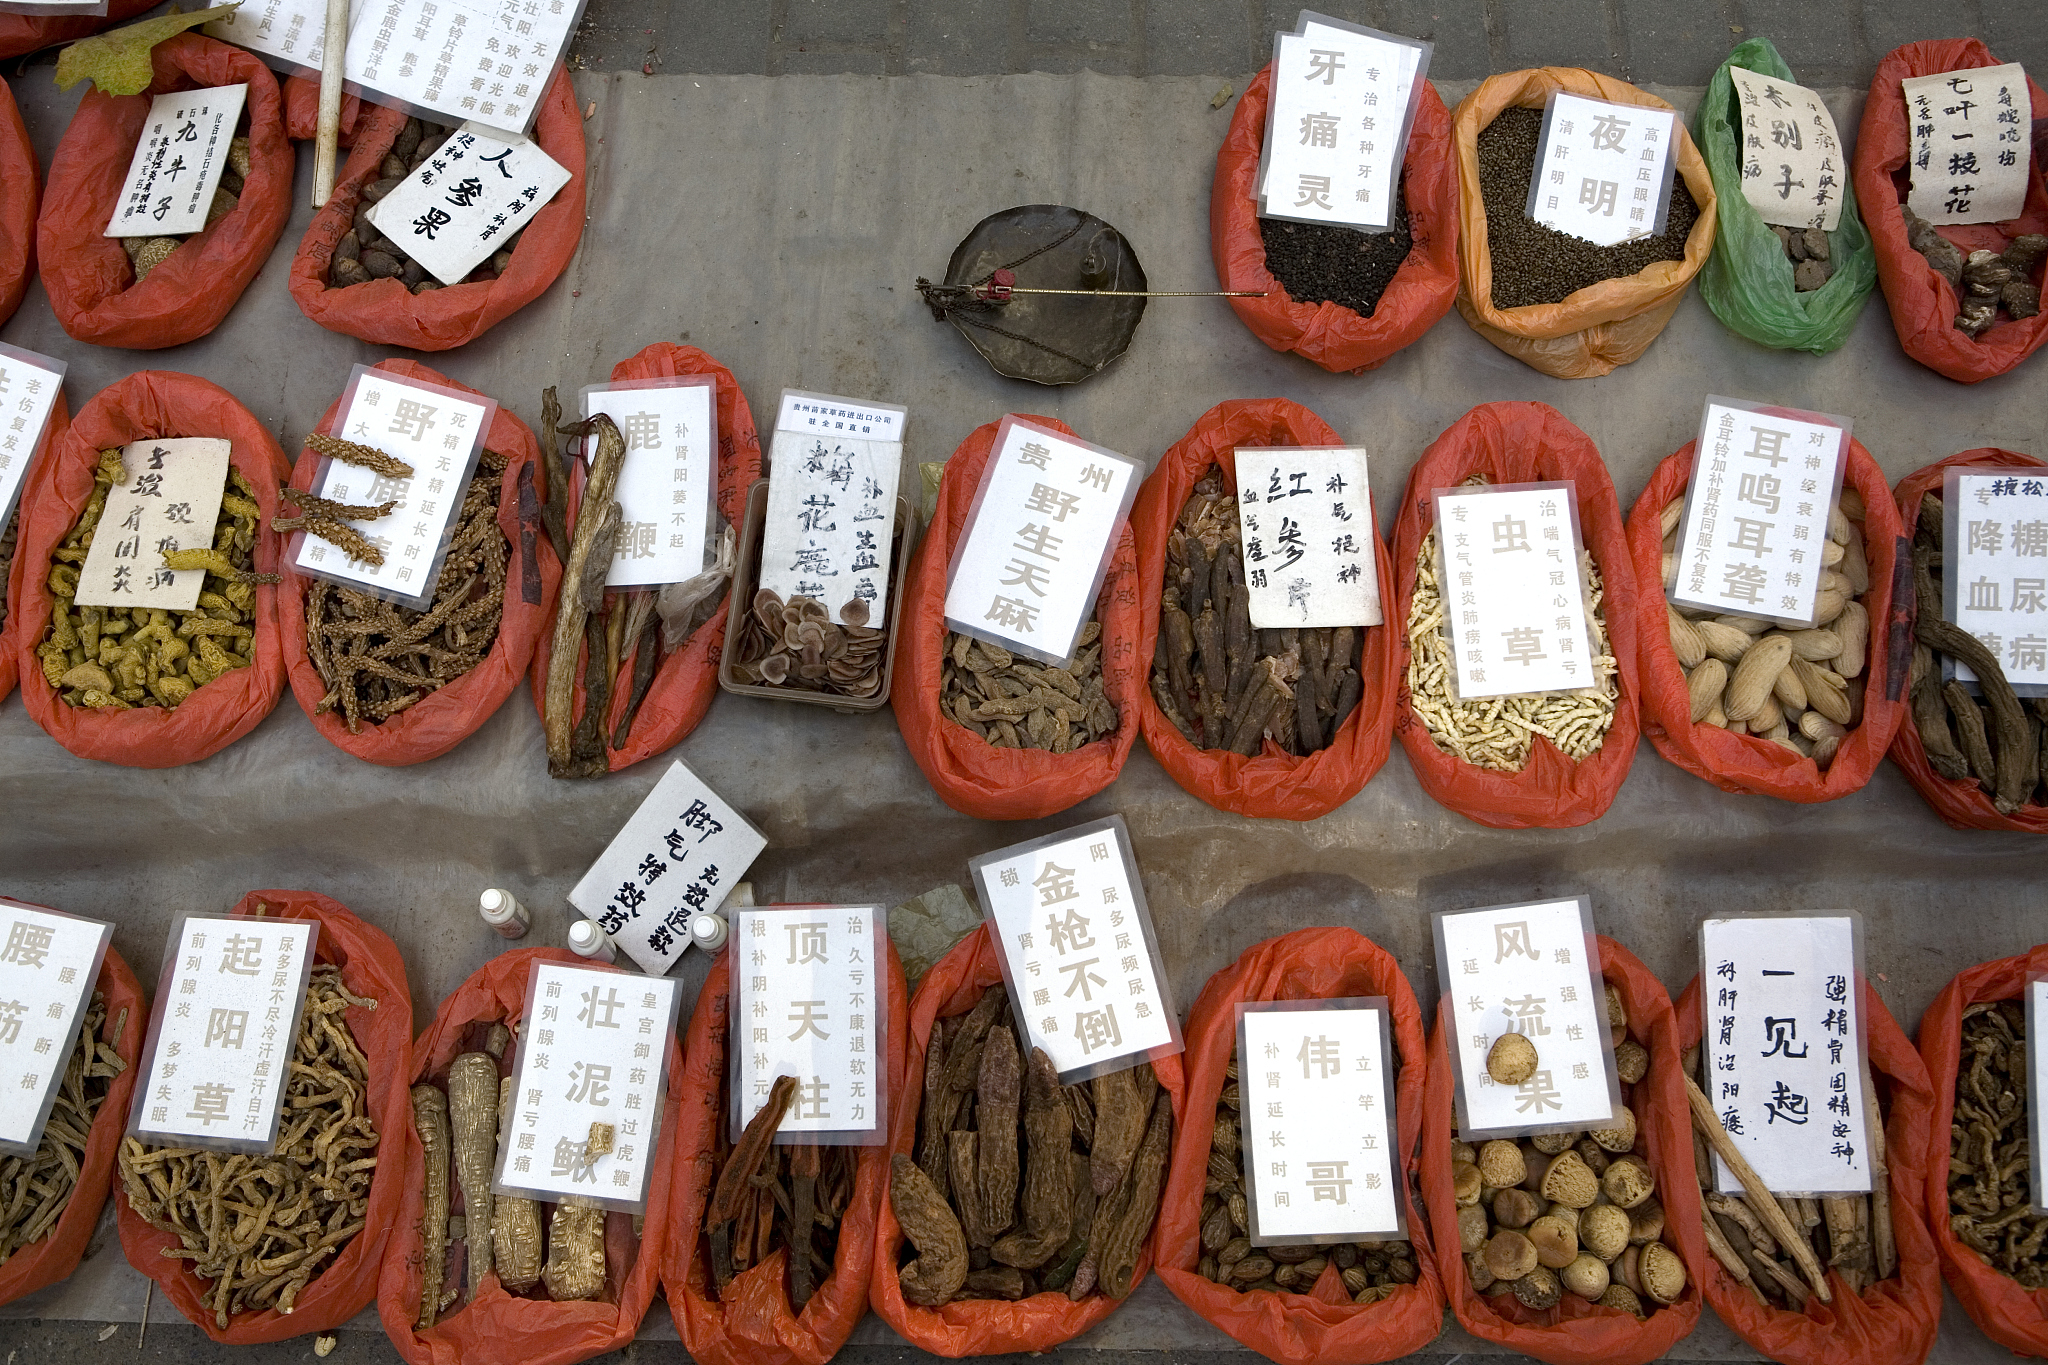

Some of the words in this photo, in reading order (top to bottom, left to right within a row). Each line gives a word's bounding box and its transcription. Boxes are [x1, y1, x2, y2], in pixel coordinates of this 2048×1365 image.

[461, 37, 499, 110] 免费看病
[480, 44, 520, 115] 欢迎光临
[504, 42, 547, 117] 无效退款
[1293, 49, 1346, 211] 牙痛灵
[1355, 67, 1381, 203] 专治各种牙痛
[614, 410, 662, 561] 鹿鞭
[669, 422, 689, 548] 补肾阳萎不起
[793, 403, 892, 424] 贵州苗家草药进出口公司
[808, 417, 871, 434] 驻全国直销
[396, 411, 468, 583] 死精无精延长时间
[984, 482, 1082, 633] 野生天麻
[1688, 412, 1735, 594] 金耳铃加补肾药同服不复发
[1720, 426, 1791, 605] 耳鸣耳聋
[1781, 432, 1825, 611] 对神经衰弱有特效
[1492, 514, 1548, 666] 虫草
[20, 966, 77, 1090] 腰痛断根
[784, 921, 831, 1120] 顶天柱
[1017, 932, 1059, 1035] 肾亏腰痛
[1032, 861, 1123, 1055] 金枪不倒
[1101, 886, 1153, 1019] 尿多尿频尿急
[1462, 958, 1495, 1089] 延长时间
[1493, 920, 1563, 1115] 风流果
[1554, 948, 1590, 1080] 增强性感
[186, 933, 263, 1126] 起阳草
[243, 936, 295, 1132] 尿多尿不尽冷汗虚汗自汗
[551, 985, 625, 1185] 壮泥鳅
[612, 992, 658, 1187] 皇宫御药胜过虎鞭
[1761, 969, 1809, 1126] 一见起
[1264, 1042, 1290, 1208] 补肾延长时间
[1296, 1034, 1353, 1206] 伟哥
[1355, 1056, 1382, 1190] 立竿立影
